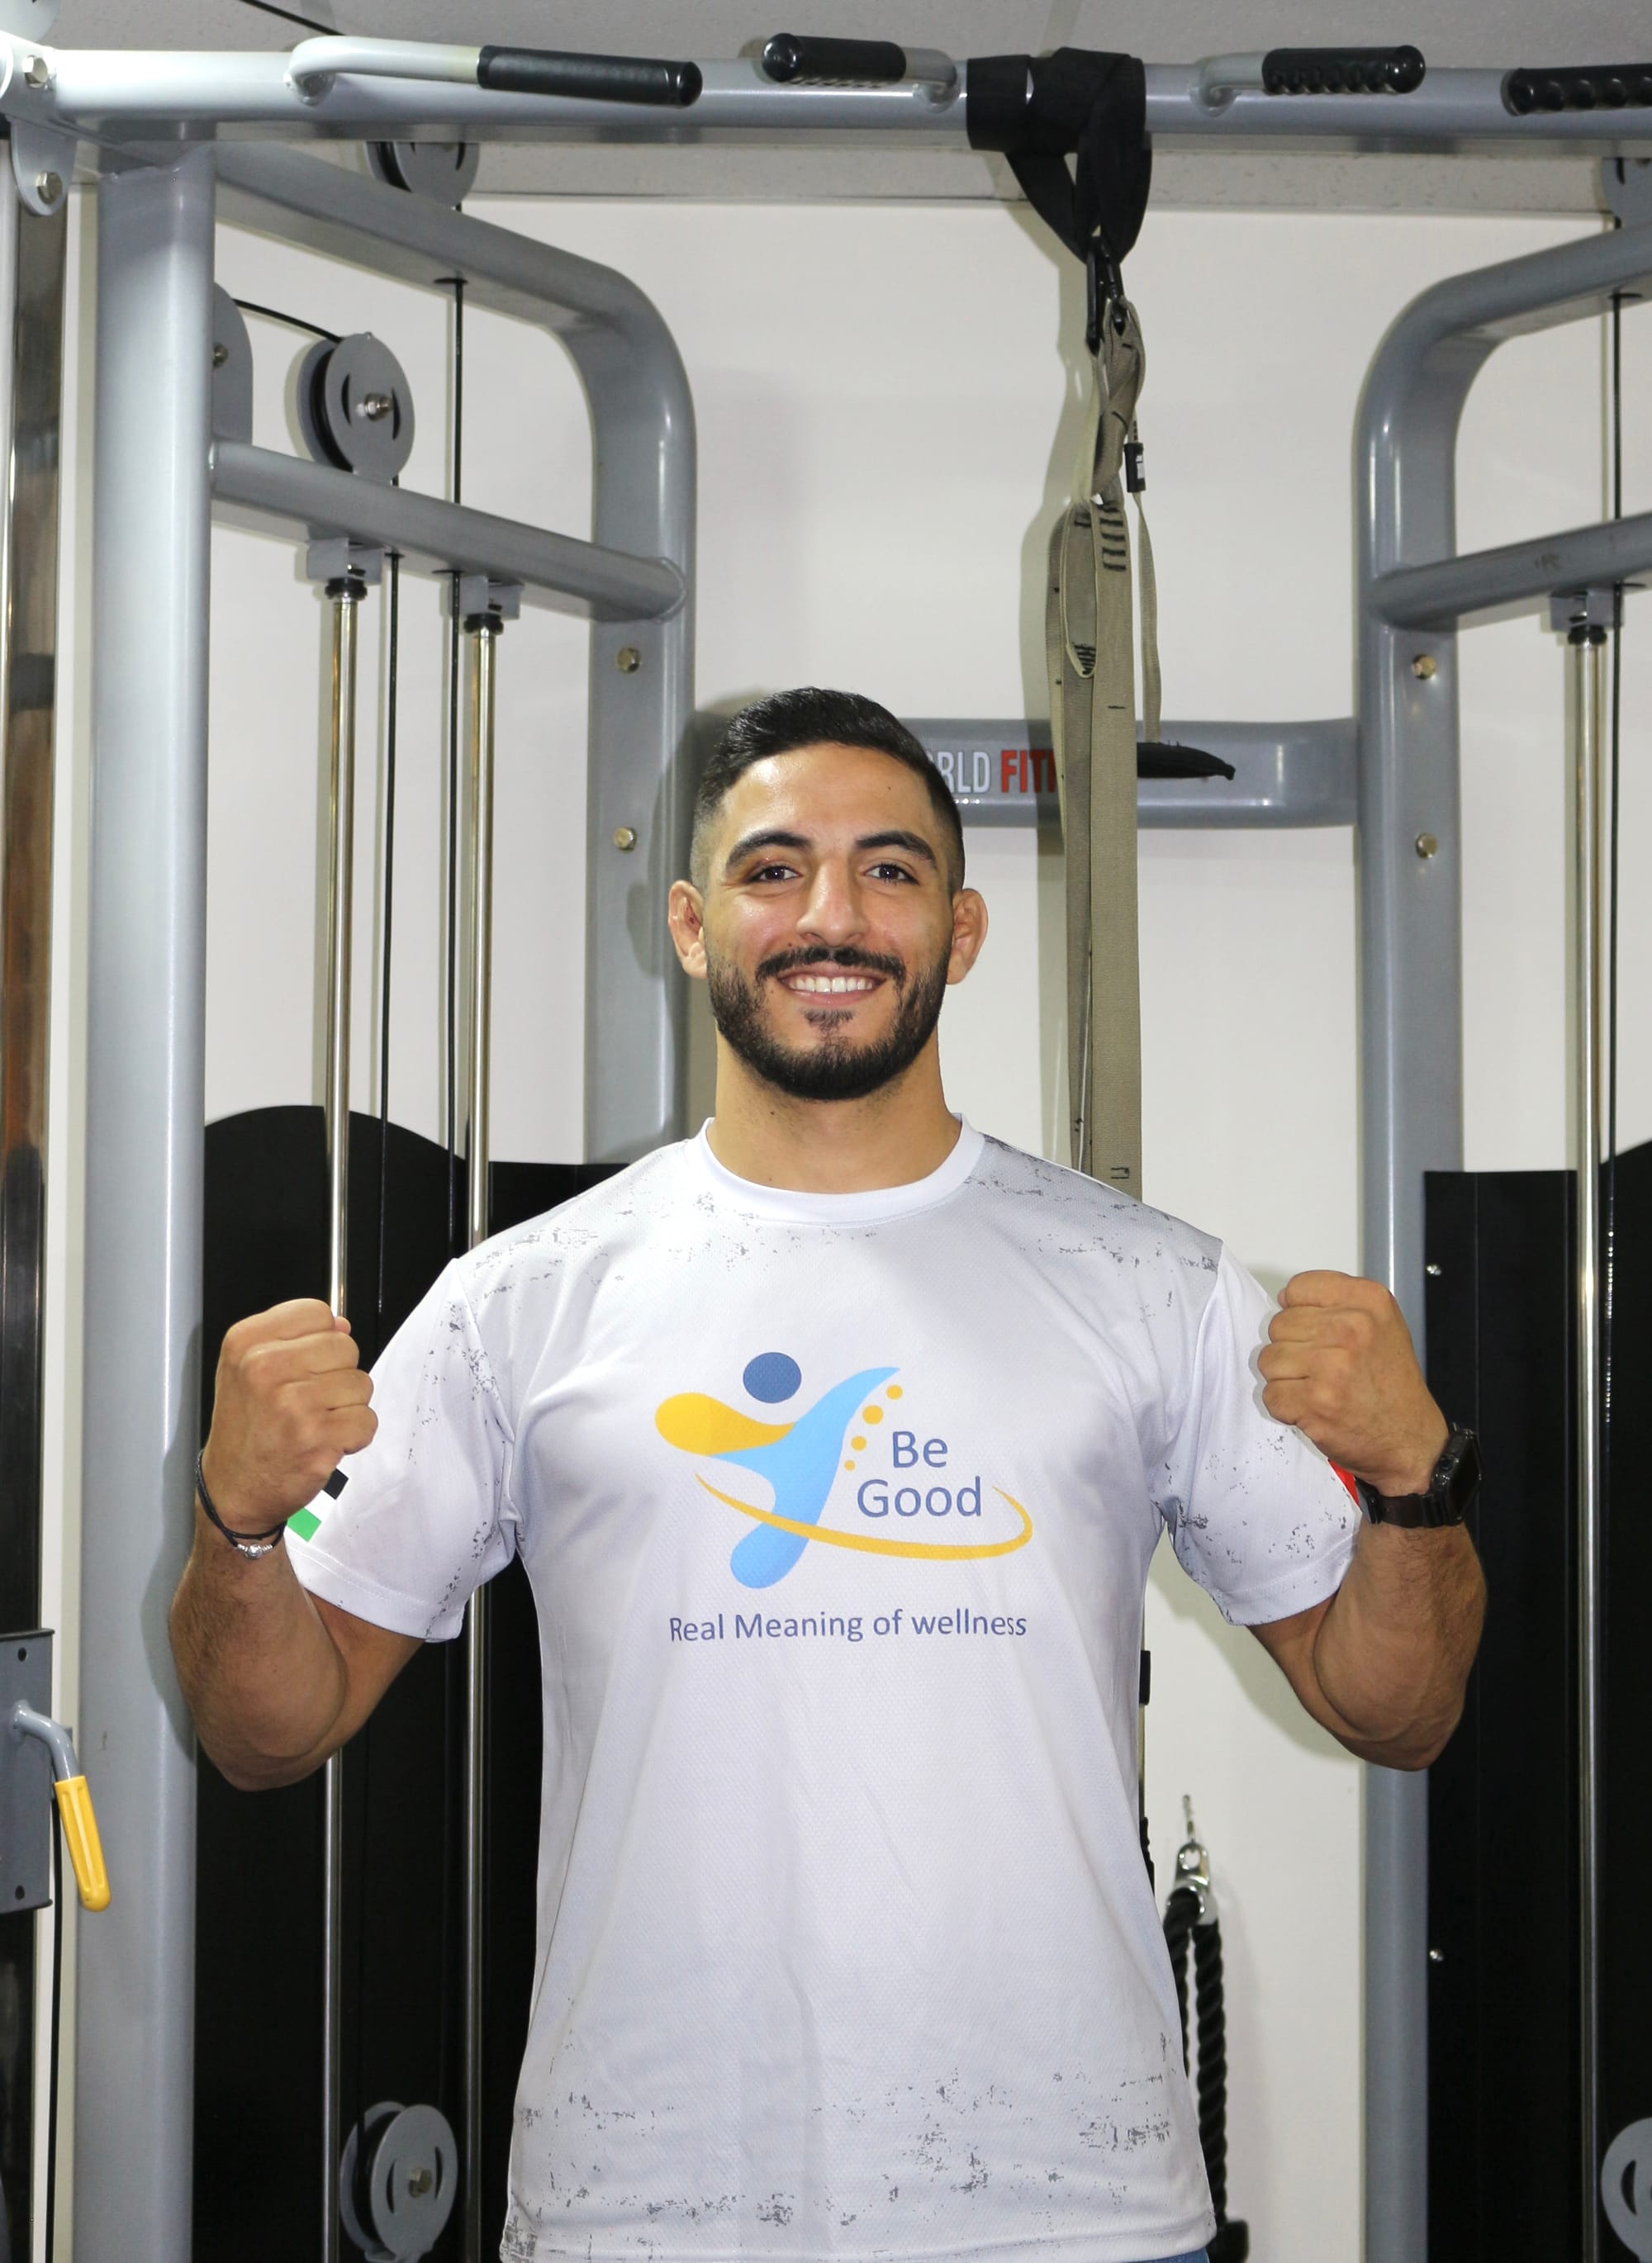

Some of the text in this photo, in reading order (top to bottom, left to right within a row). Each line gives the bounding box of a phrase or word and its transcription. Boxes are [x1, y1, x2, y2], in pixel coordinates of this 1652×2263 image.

[927, 751, 991, 794] RLD
[892, 1430, 949, 1468] Be
[857, 1475, 981, 1518] Good
[669, 1607, 1028, 1643] Real Meaning of wellness
